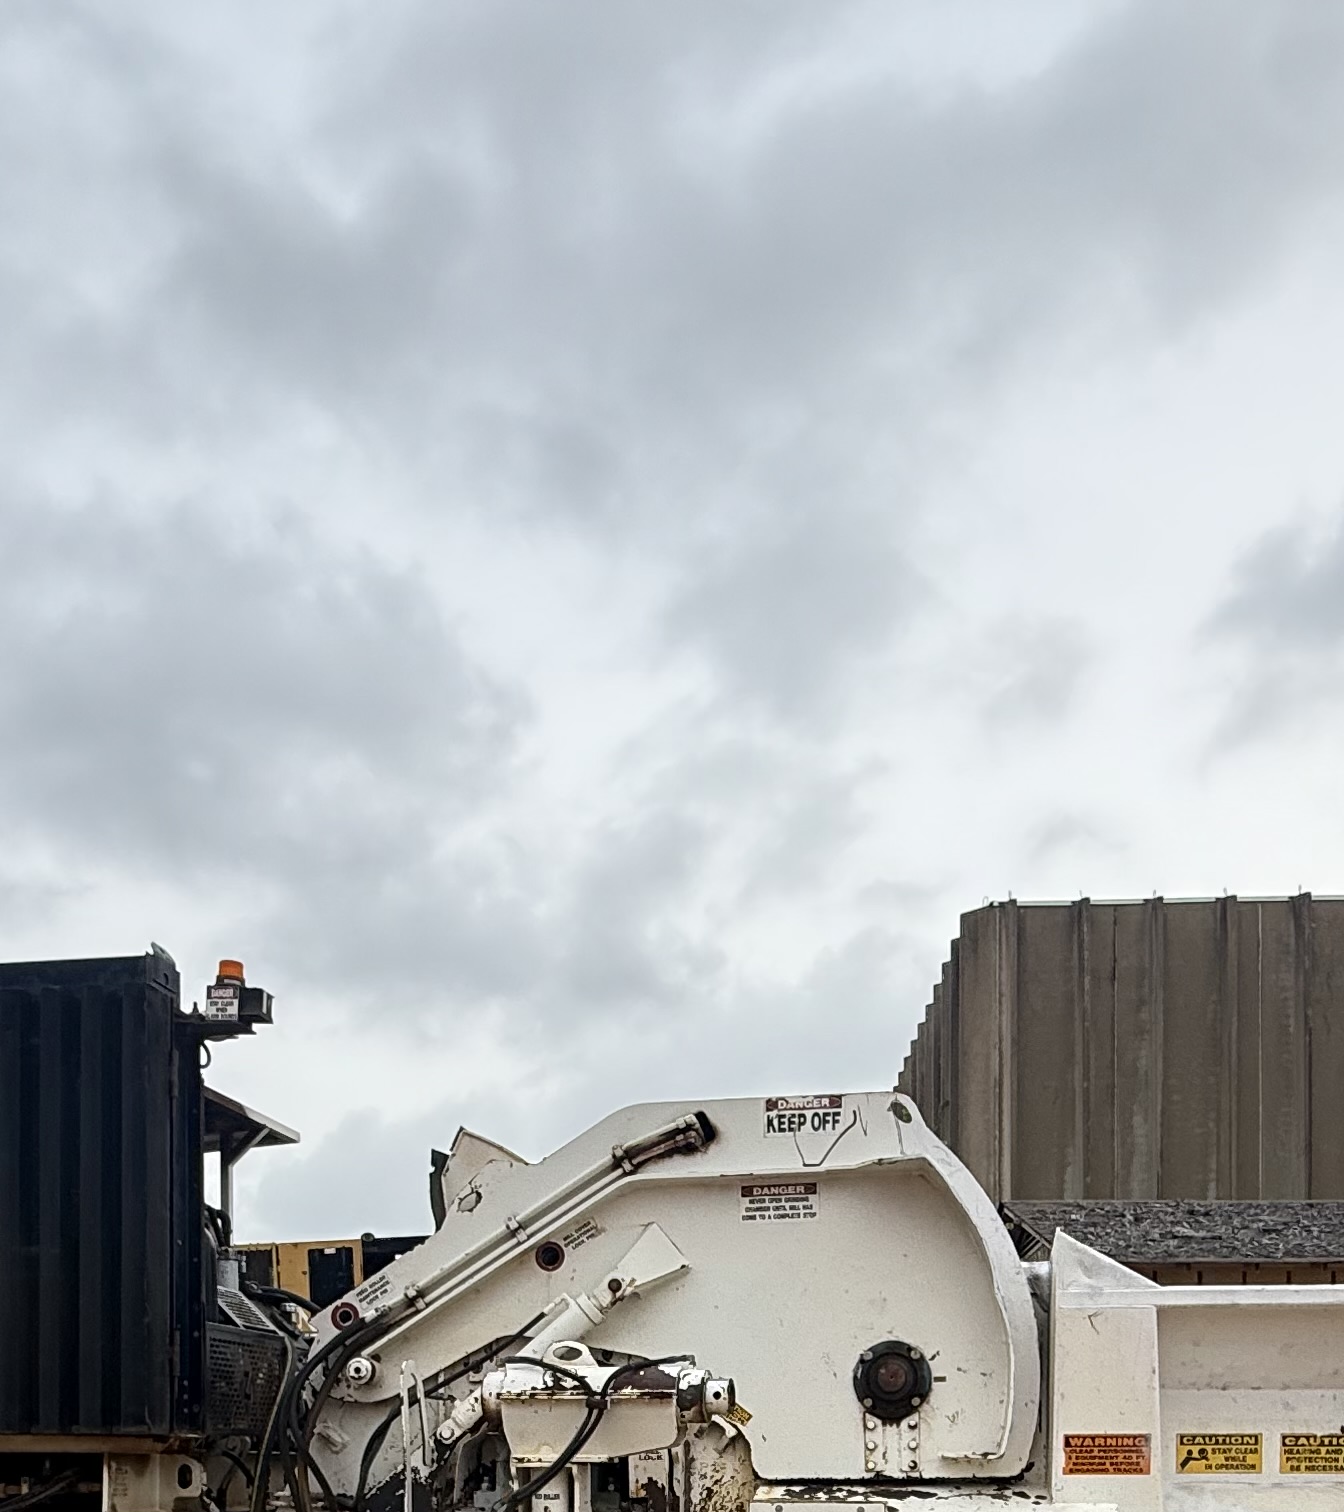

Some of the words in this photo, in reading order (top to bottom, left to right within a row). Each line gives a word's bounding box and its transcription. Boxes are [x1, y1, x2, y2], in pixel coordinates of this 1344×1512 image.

[777, 1097, 830, 1109] DANGER
[766, 1113, 807, 1134] KEEP
[811, 1112, 841, 1132] OFF
[753, 1185, 805, 1195] DANGER
[1069, 1437, 1144, 1446] WARNING
[1183, 1436, 1256, 1444] CAUTION
